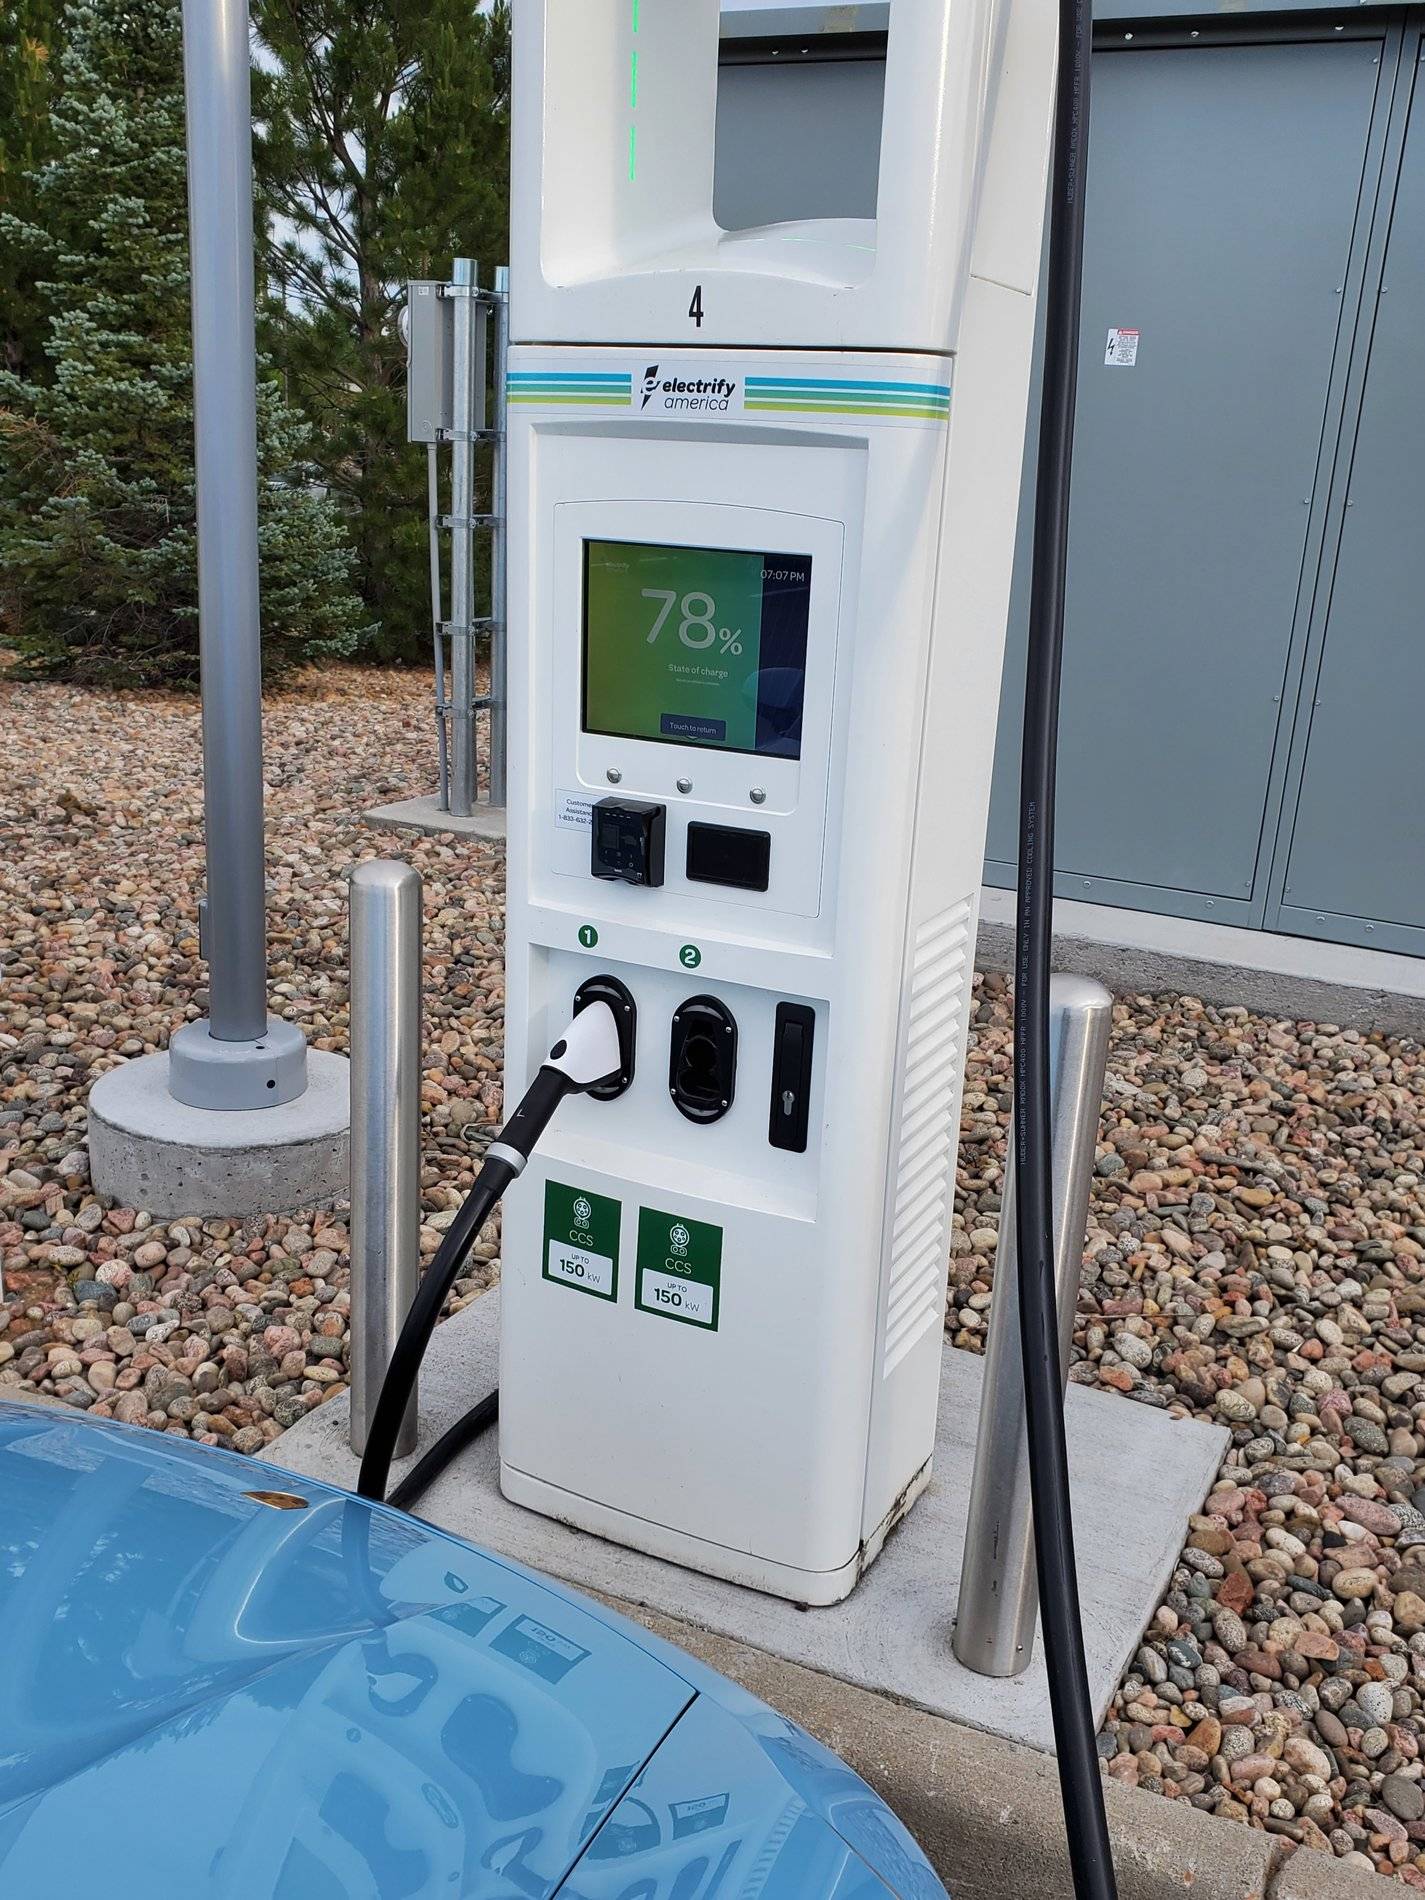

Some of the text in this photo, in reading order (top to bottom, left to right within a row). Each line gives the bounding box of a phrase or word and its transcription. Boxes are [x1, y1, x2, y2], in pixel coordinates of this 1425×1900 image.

[688, 285, 704, 328] 4
[662, 377, 736, 398] electrify
[664, 396, 729, 411] america
[760, 569, 805, 582] 07:07 PM
[641, 588, 743, 656] 78%
[668, 664, 729, 680] State of charge
[669, 722, 689, 731] Touch
[697, 726, 717, 735] return
[566, 798, 593, 808] Custome
[565, 807, 592, 817] Assistanc
[1028, 801, 1036, 829] SYSTEM
[584, 929, 592, 945] 1
[684, 949, 696, 965] 2
[569, 1230, 594, 1247] CCS
[571, 1253, 590, 1265] UP TO
[665, 1257, 692, 1275] CCS
[559, 1258, 601, 1284] 150 kW
[677, 1284, 688, 1293] TO
[654, 1287, 700, 1313] 150 kW
